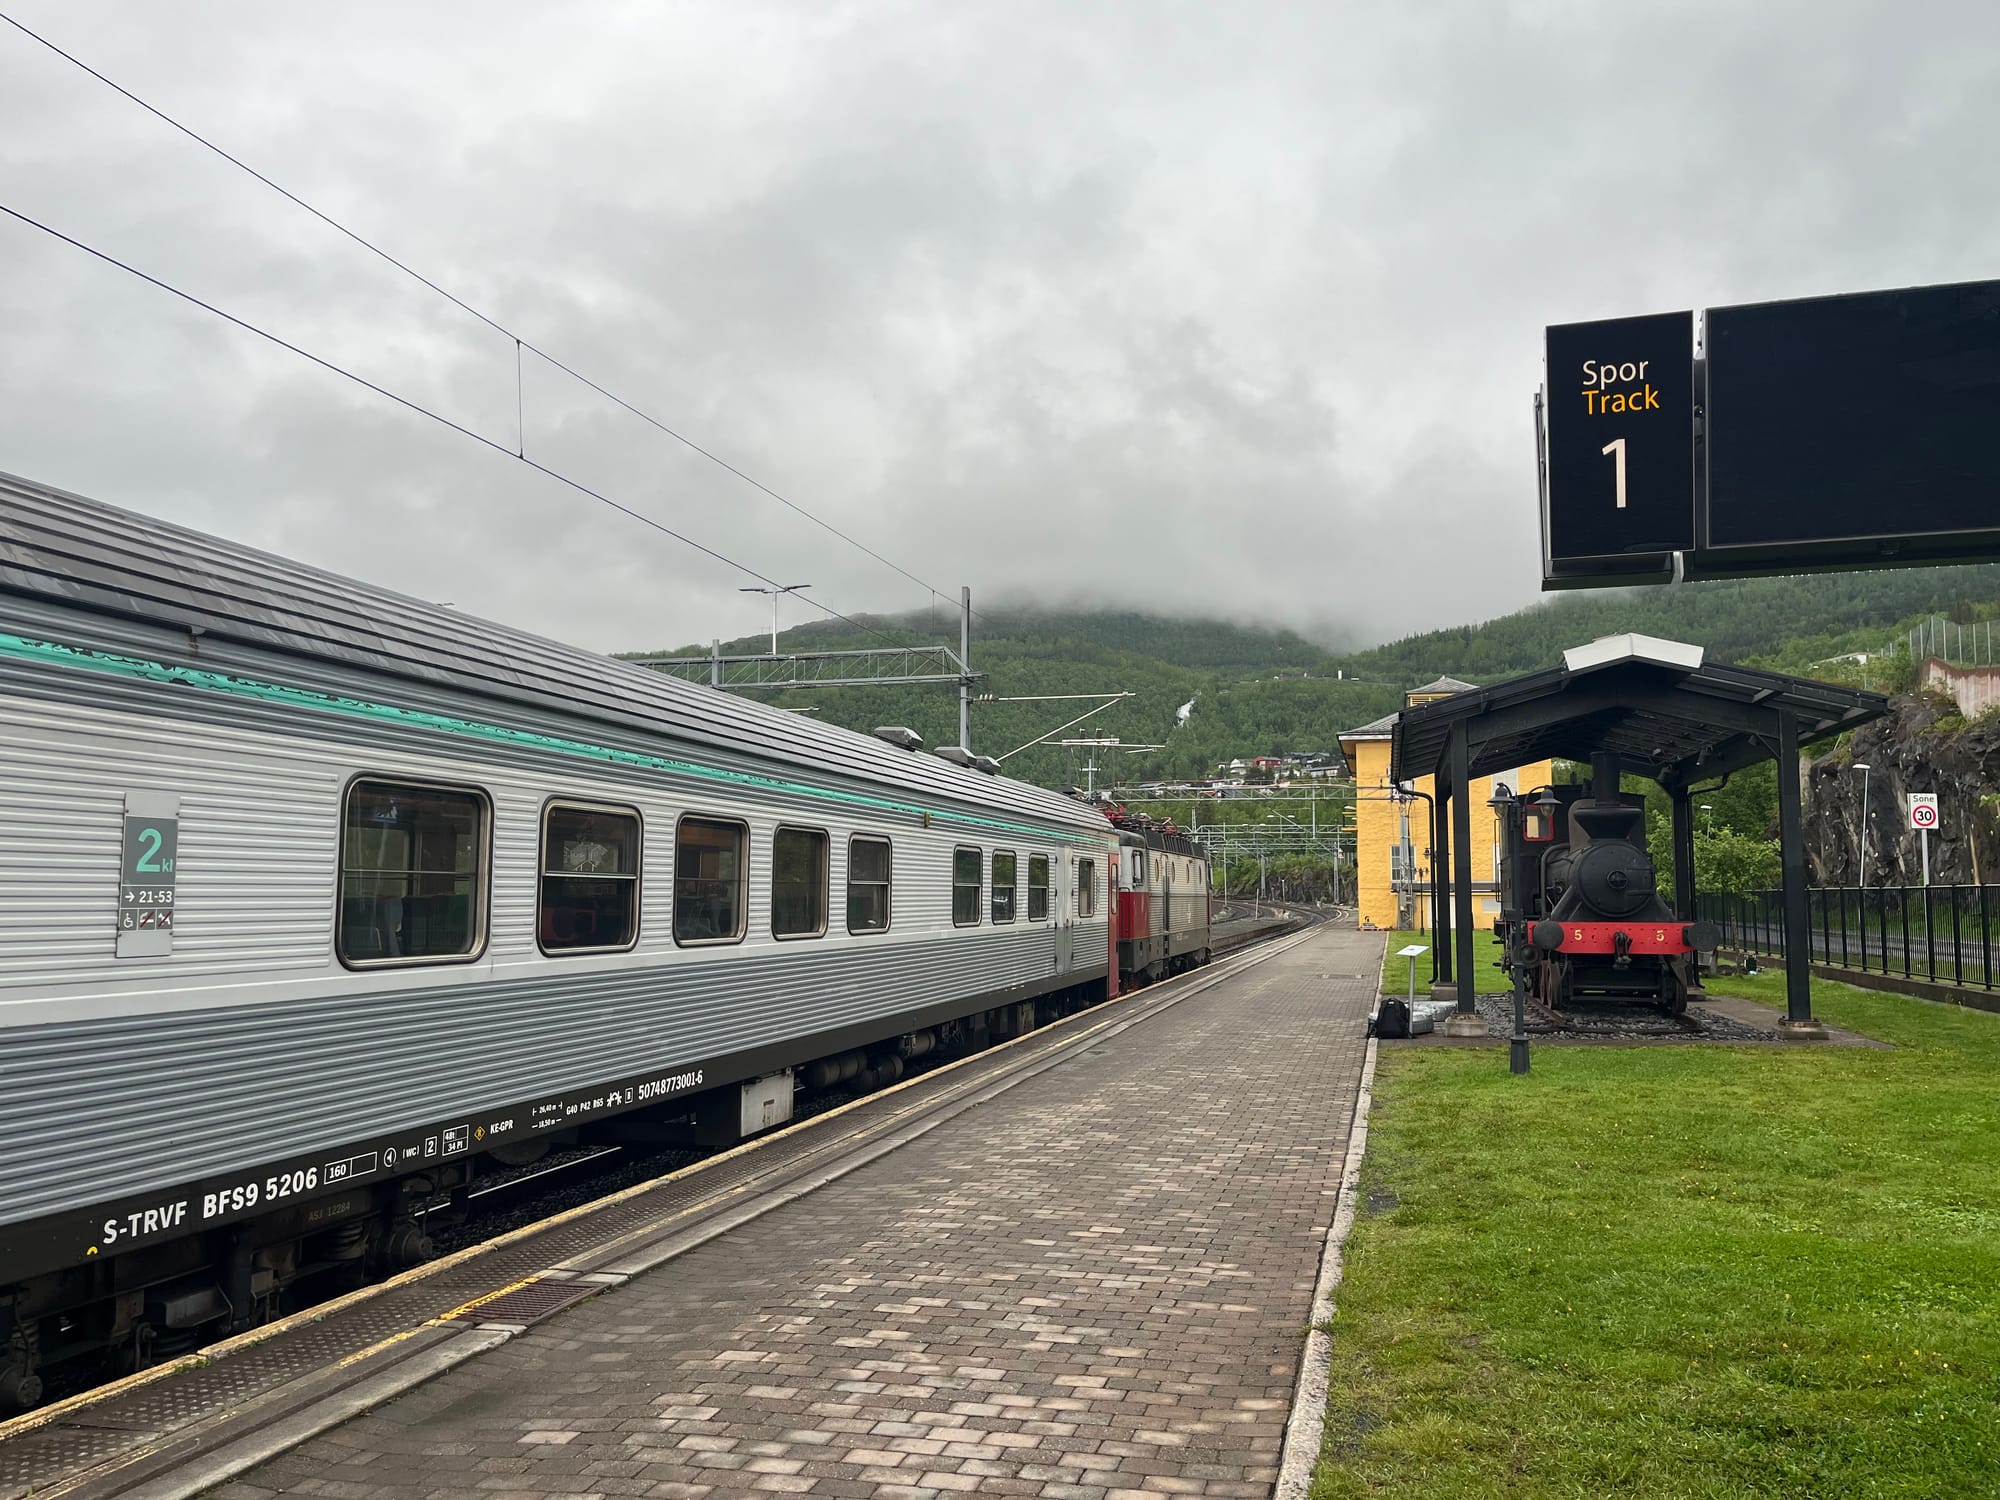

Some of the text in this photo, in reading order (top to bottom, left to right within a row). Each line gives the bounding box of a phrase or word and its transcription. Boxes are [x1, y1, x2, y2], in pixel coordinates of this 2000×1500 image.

[1582, 360, 1649, 390] Spor
[1582, 384, 1660, 415] Track
[1601, 438, 1627, 509] 1
[1913, 794, 1935, 803] Sone
[1917, 810, 1932, 821] 30
[136, 827, 174, 873] 2 kl
[139, 890, 173, 903] 21-53
[1574, 929, 1583, 941] 5
[1655, 929, 1665, 942] 5
[638, 1069, 703, 1101] 50748773001-6
[566, 1104, 578, 1115] G40
[580, 1100, 591, 1112] P42
[490, 1119, 514, 1135] KE-GPR
[427, 1140, 434, 1154] 2
[447, 1142, 456, 1152] 34
[329, 1164, 347, 1180] 160
[102, 1166, 318, 1245] S-TRVF BFS9 5206
